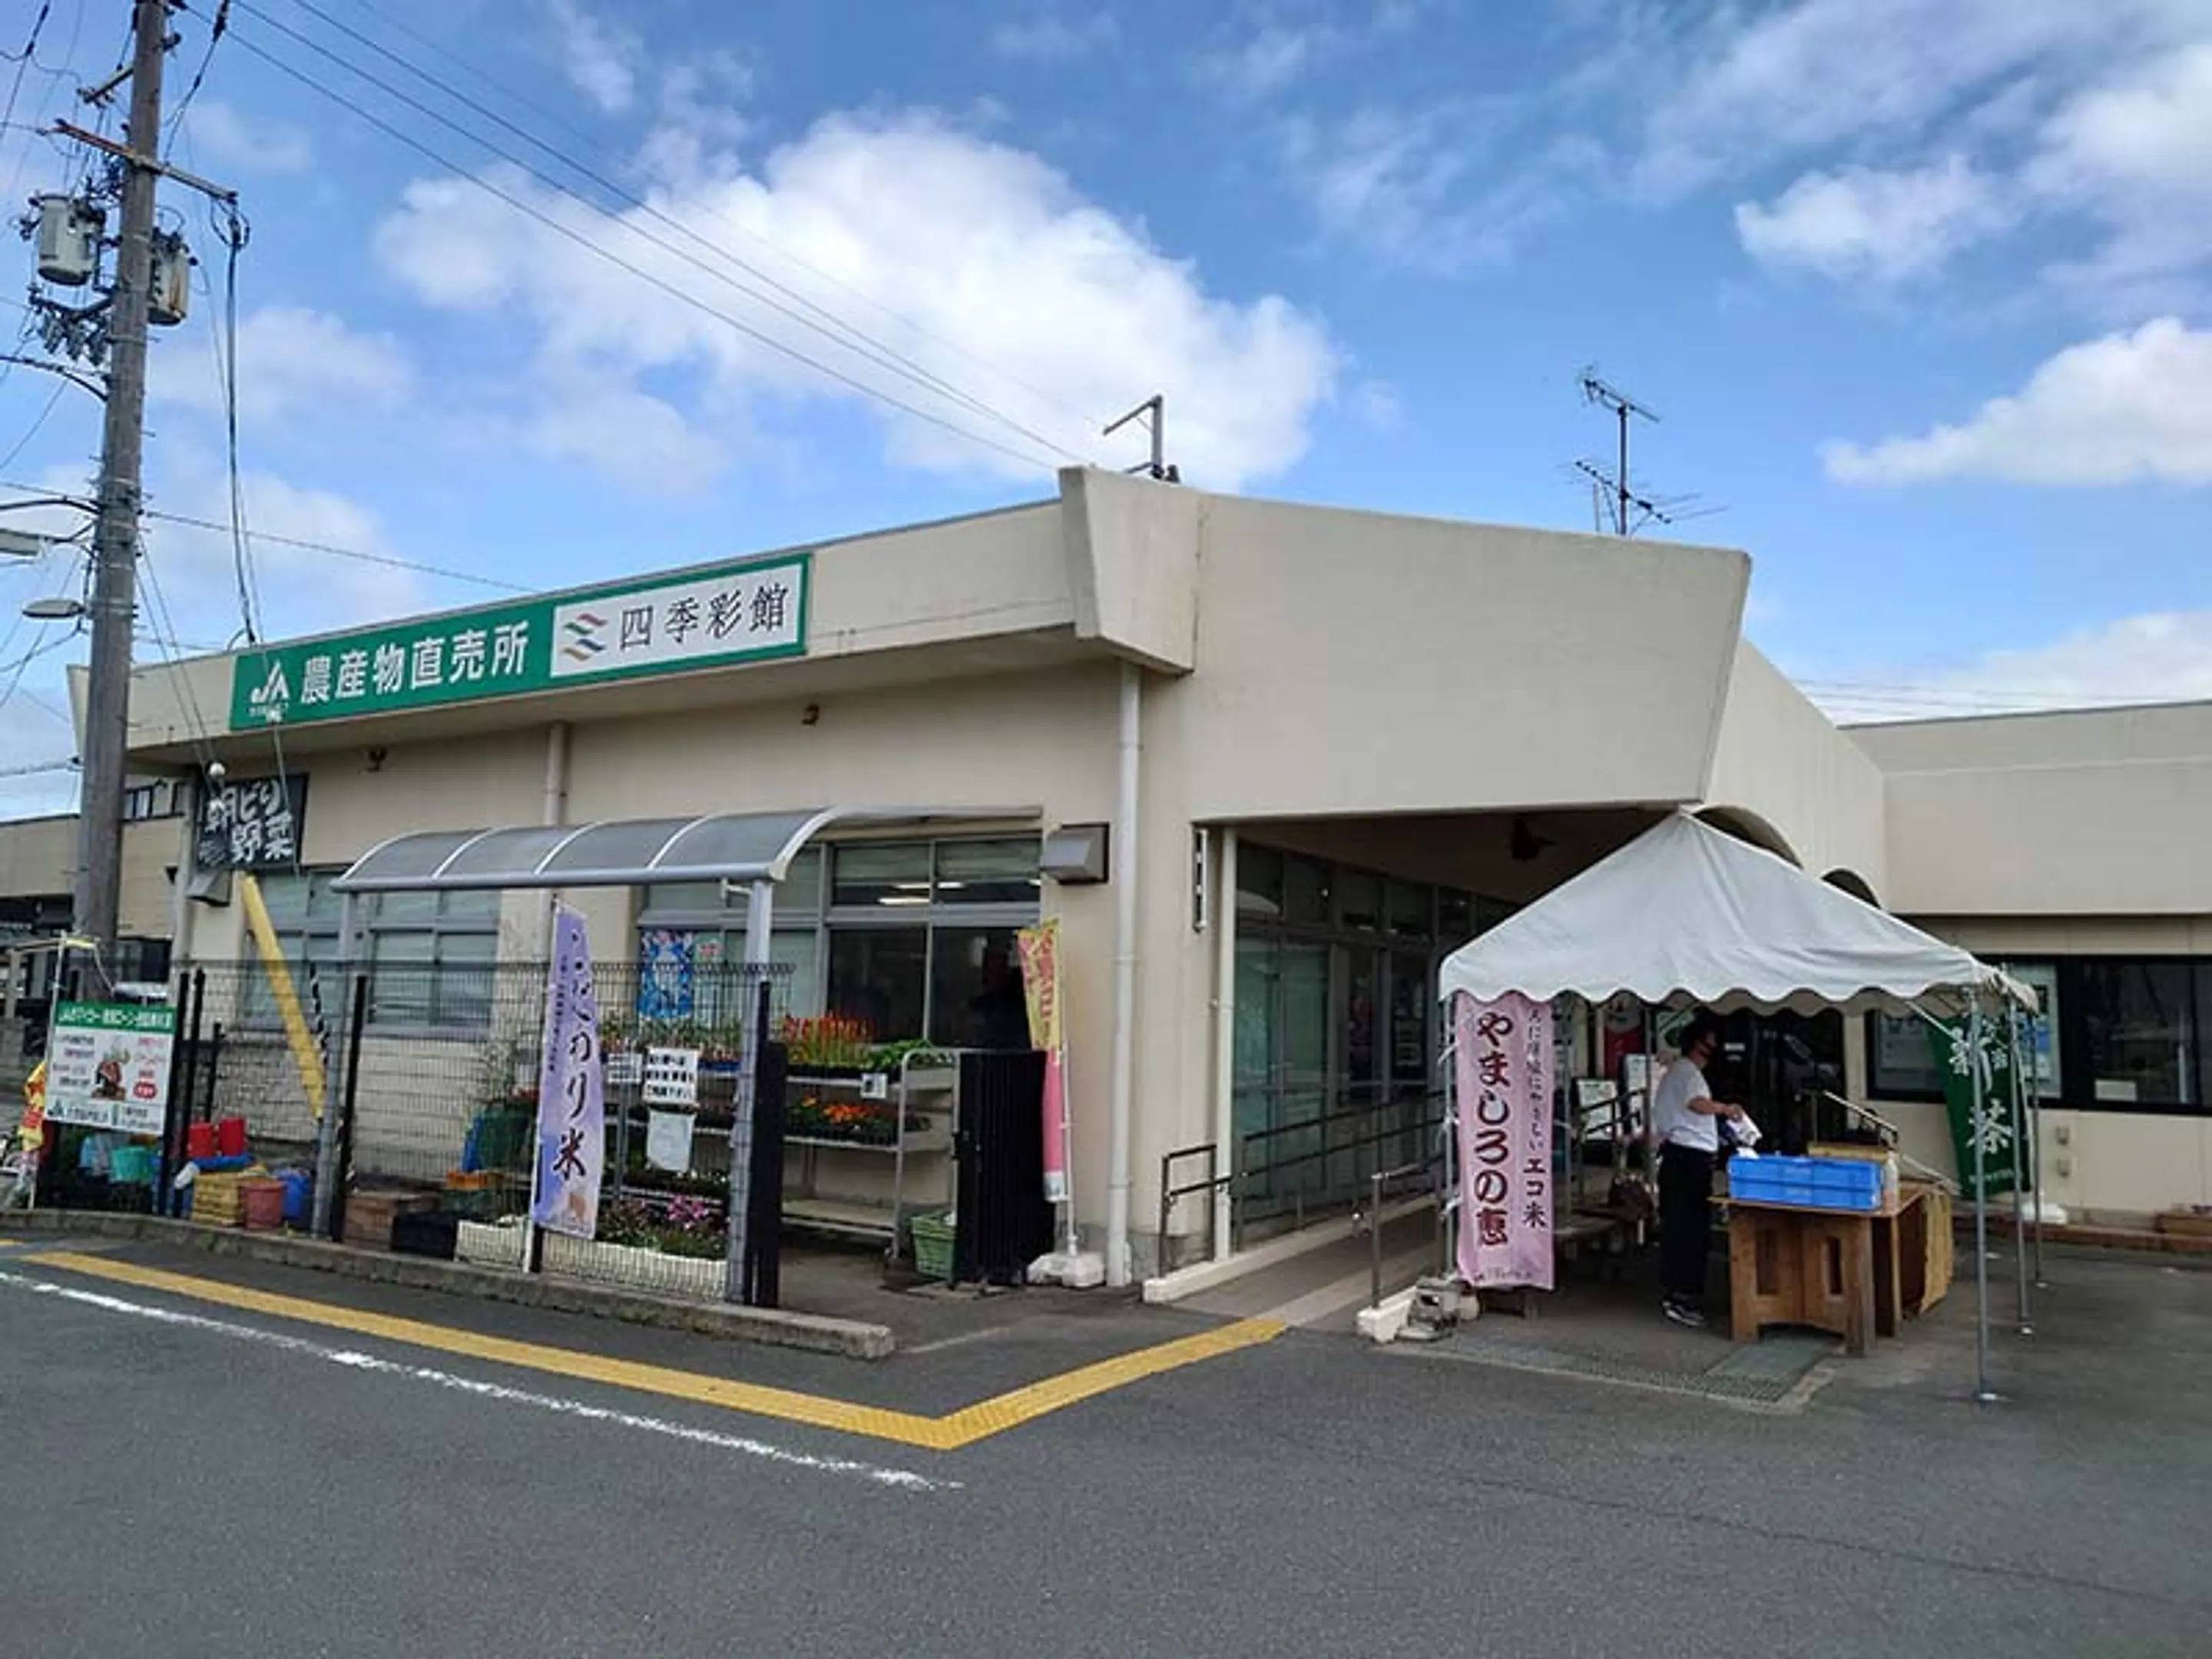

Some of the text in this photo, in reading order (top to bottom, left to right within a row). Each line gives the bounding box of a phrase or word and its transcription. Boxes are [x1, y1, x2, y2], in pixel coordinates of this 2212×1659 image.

[619, 583, 790, 652] 四季彩館
[299, 620, 530, 704] 農産物直売所
[231, 809, 294, 863] 野菜
[1473, 1011, 1514, 1247] やましろの恵
